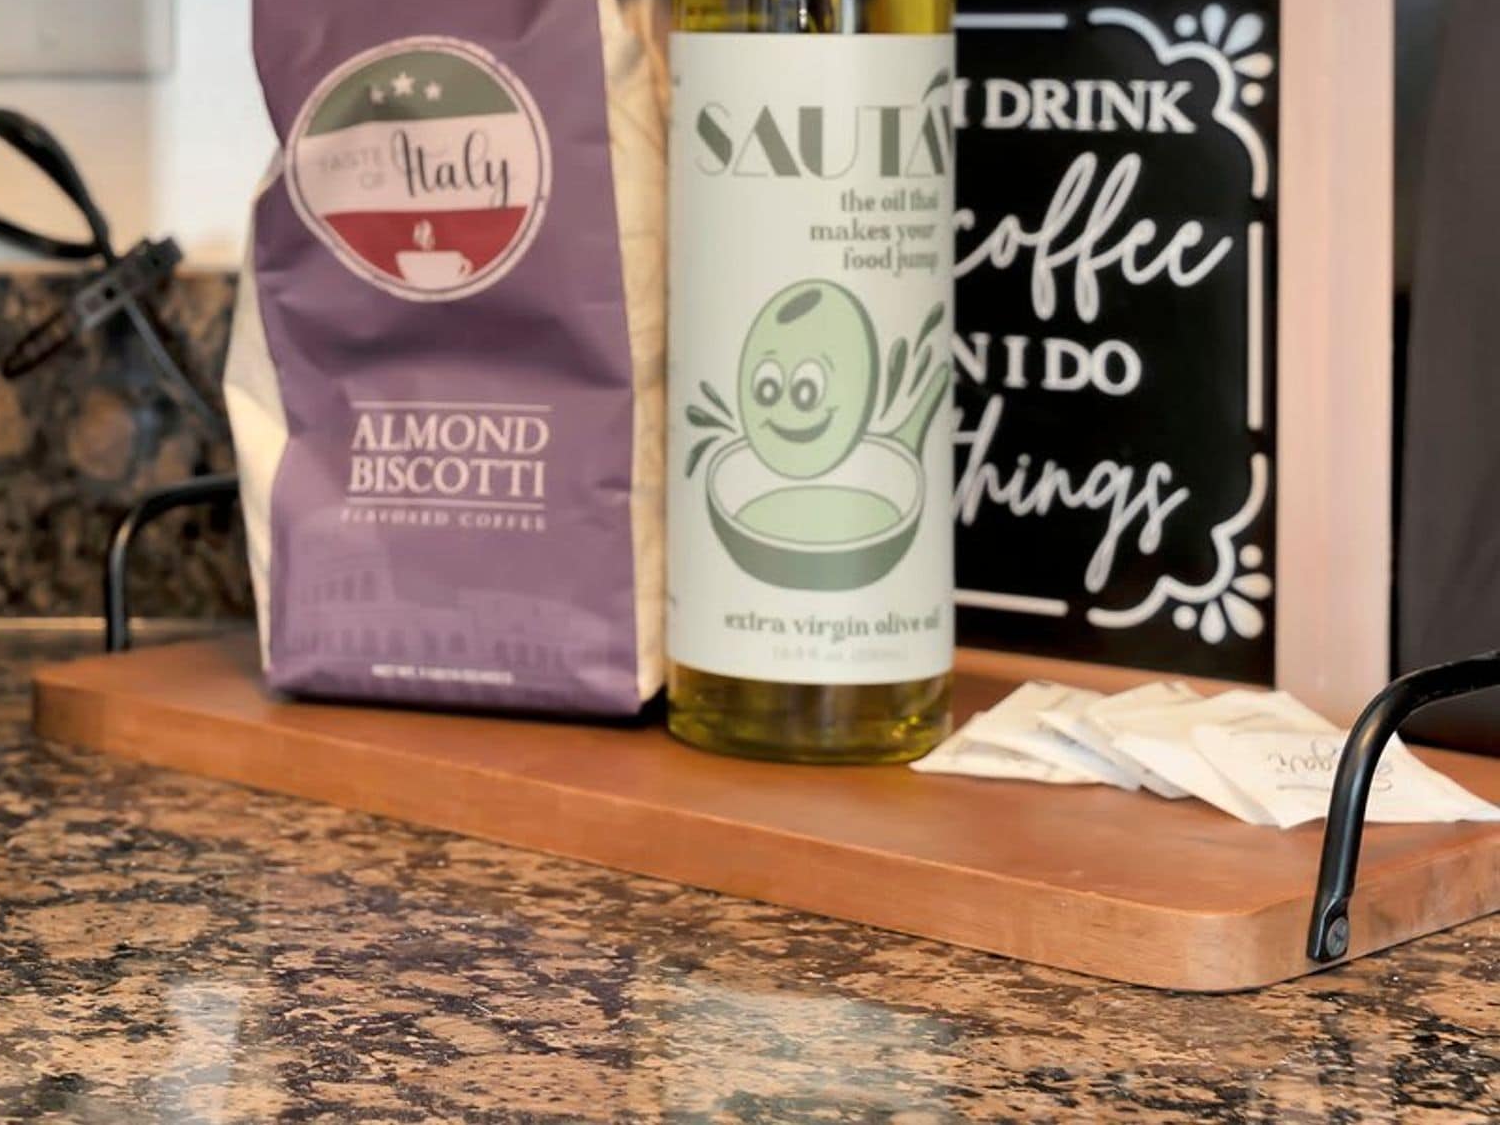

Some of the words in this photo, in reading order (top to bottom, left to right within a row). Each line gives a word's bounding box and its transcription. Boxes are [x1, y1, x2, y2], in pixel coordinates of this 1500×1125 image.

[982, 78, 1197, 134] DRINK
[391, 128, 513, 210] Italy
[840, 187, 876, 212] the
[881, 187, 907, 212] oil
[809, 218, 891, 242] makes
[843, 246, 892, 271] food
[1001, 335, 1030, 390] I
[1041, 337, 1143, 397] DO
[350, 412, 550, 454] ALMOND
[348, 455, 547, 498] BISCOTTI
[723, 611, 786, 635] extra
[793, 611, 870, 642] virgin
[875, 610, 920, 635] olive
